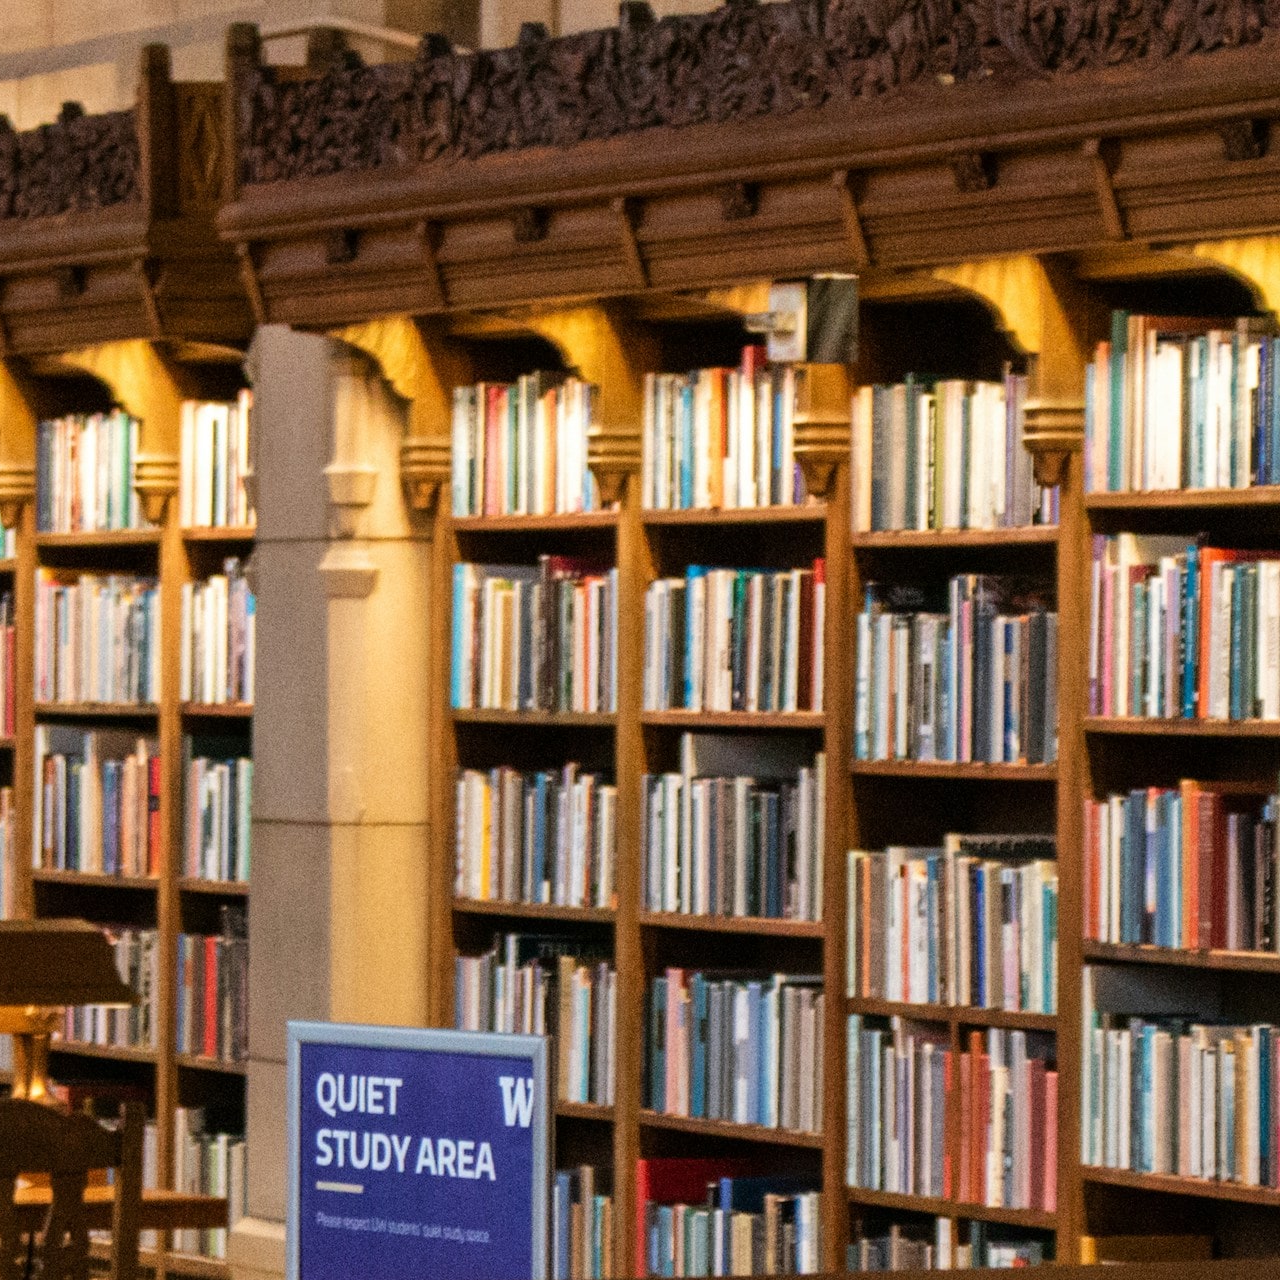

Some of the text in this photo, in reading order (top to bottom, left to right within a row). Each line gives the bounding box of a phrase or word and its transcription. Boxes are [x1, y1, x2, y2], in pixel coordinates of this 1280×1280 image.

[316, 1072, 403, 1117] QUIET
[498, 1076, 534, 1128] W
[315, 1128, 497, 1181] STUDY AREA
[316, 1211, 342, 1229] Please
[343, 1217, 370, 1232] respect
[422, 1224, 442, 1239] quiet
[443, 1226, 465, 1244] study
